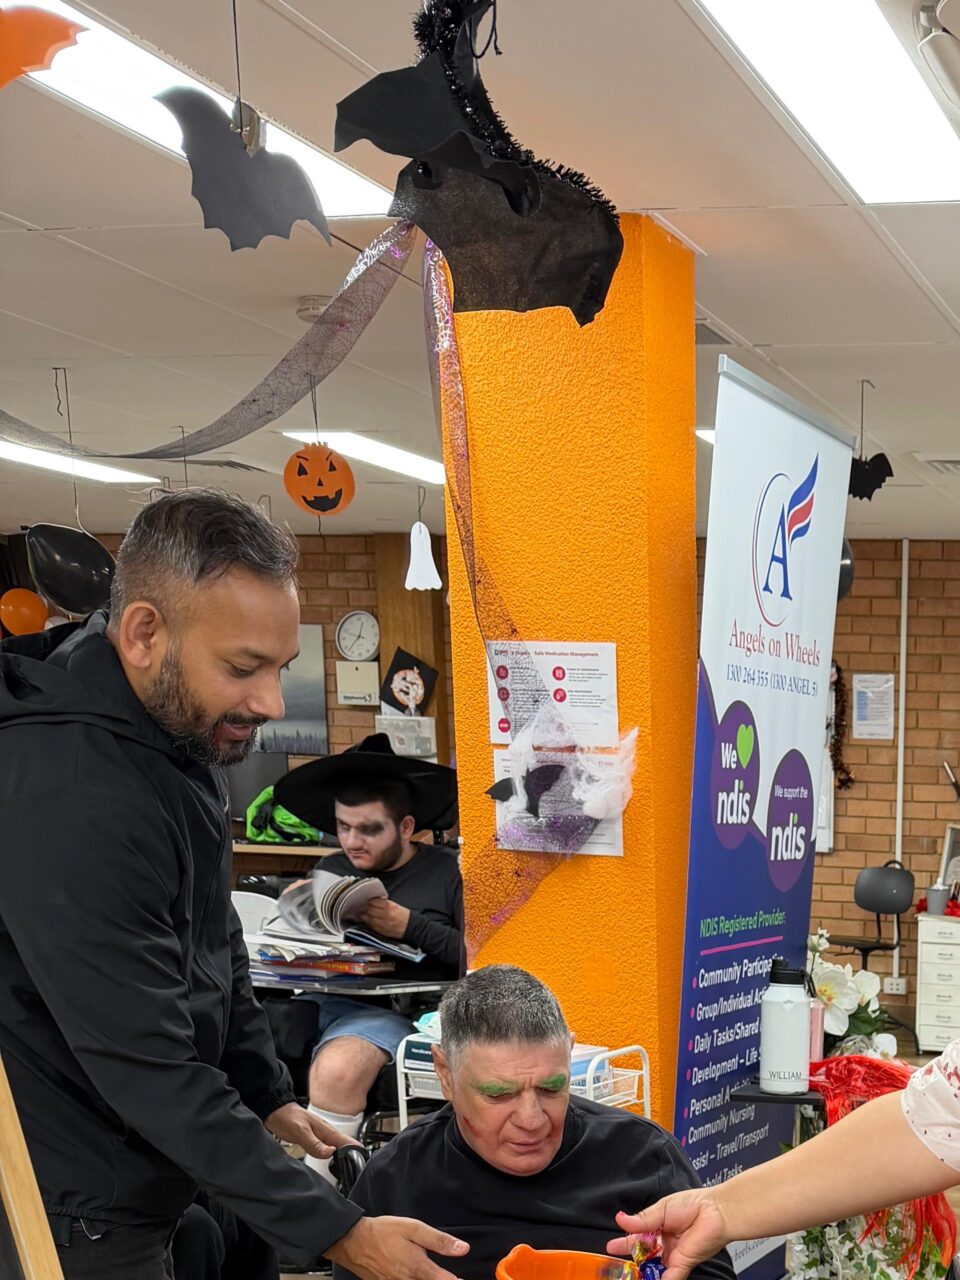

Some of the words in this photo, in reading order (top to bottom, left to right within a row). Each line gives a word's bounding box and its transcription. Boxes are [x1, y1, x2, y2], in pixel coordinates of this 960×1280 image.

[729, 618, 766, 657] Angels
[769, 638, 781, 657] on
[785, 632, 821, 667] Wheels
[727, 664, 742, 682] 1300
[743, 666, 756, 686] 264
[757, 669, 769, 688] 355
[787, 676, 811, 696] ANGEL
[721, 742, 738, 769] We
[717, 779, 751, 824] ndis
[774, 784, 783, 798] We
[783, 786, 800, 801] support
[800, 785, 808, 799] the
[770, 812, 807, 861] ndis
[700, 916, 718, 938] NDIS
[720, 911, 758, 938] Registered
[698, 961, 742, 989] Community
[742, 952, 784, 979] Participa
[696, 989, 754, 1021] Group/Individual
[694, 1032, 712, 1054] Daily
[713, 1017, 760, 1047] Tasks/Shared
[692, 1054, 738, 1086] Development
[746, 1047, 758, 1066] Life
[769, 1071, 802, 1080] WILLIAM
[690, 1087, 724, 1118] Personal
[688, 1113, 729, 1144] Community
[729, 1104, 756, 1127] Nursing
[689, 1149, 709, 1170] ssist
[717, 1123, 770, 1161] Travel/Transport
